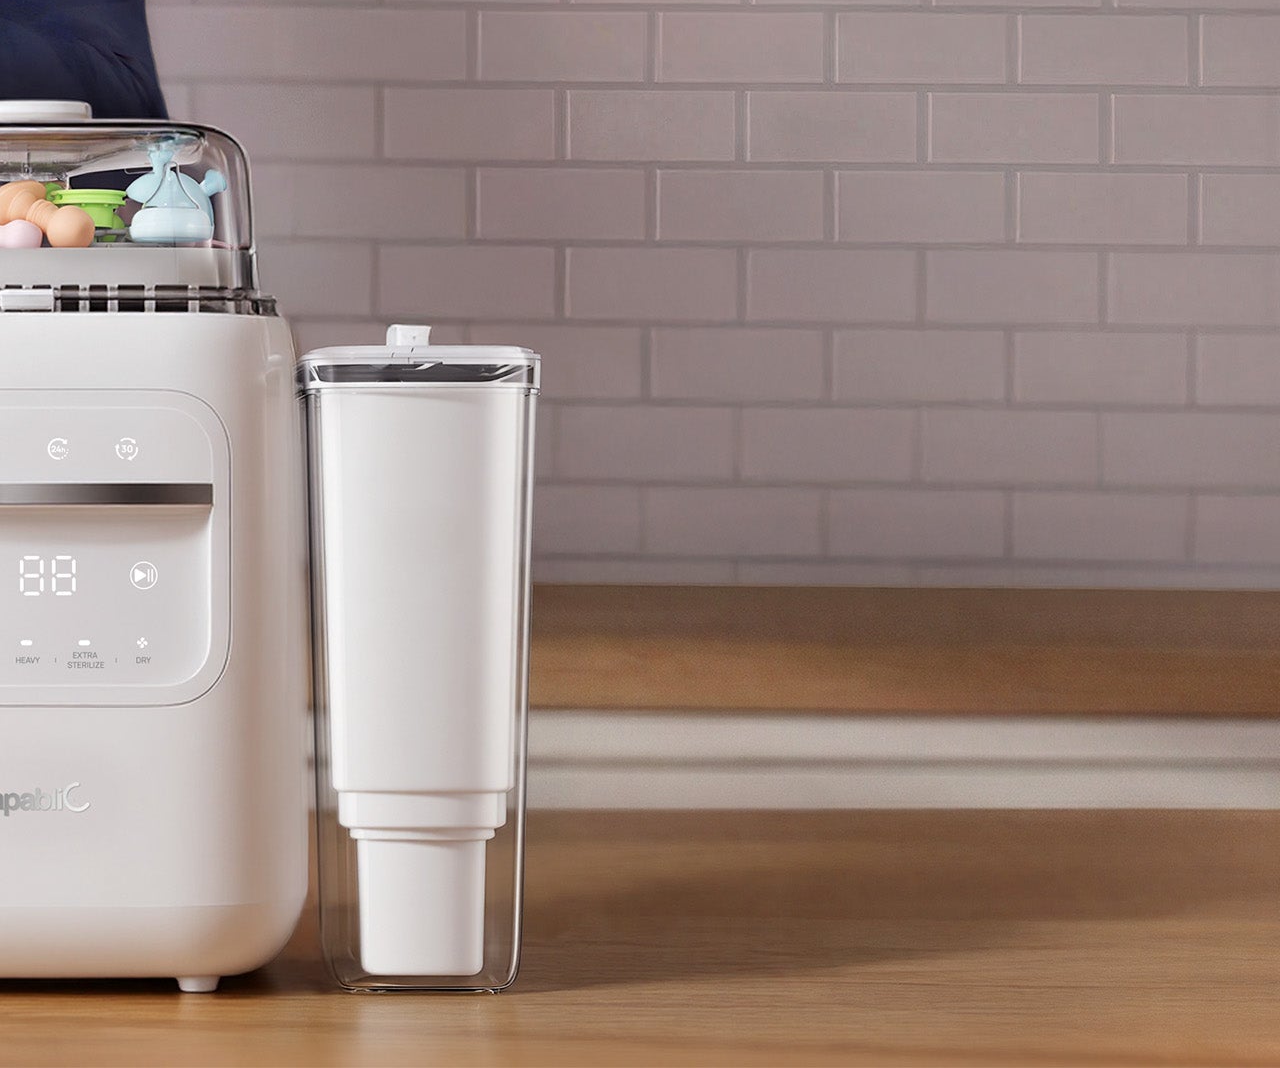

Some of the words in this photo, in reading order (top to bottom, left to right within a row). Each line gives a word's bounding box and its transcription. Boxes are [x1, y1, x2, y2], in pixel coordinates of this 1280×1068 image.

[120, 444, 134, 454] 30
[72, 651, 98, 659] EXTRA
[15, 656, 41, 664] HEAVY
[135, 656, 152, 664] DRY
[67, 661, 105, 669] STERILIZE
